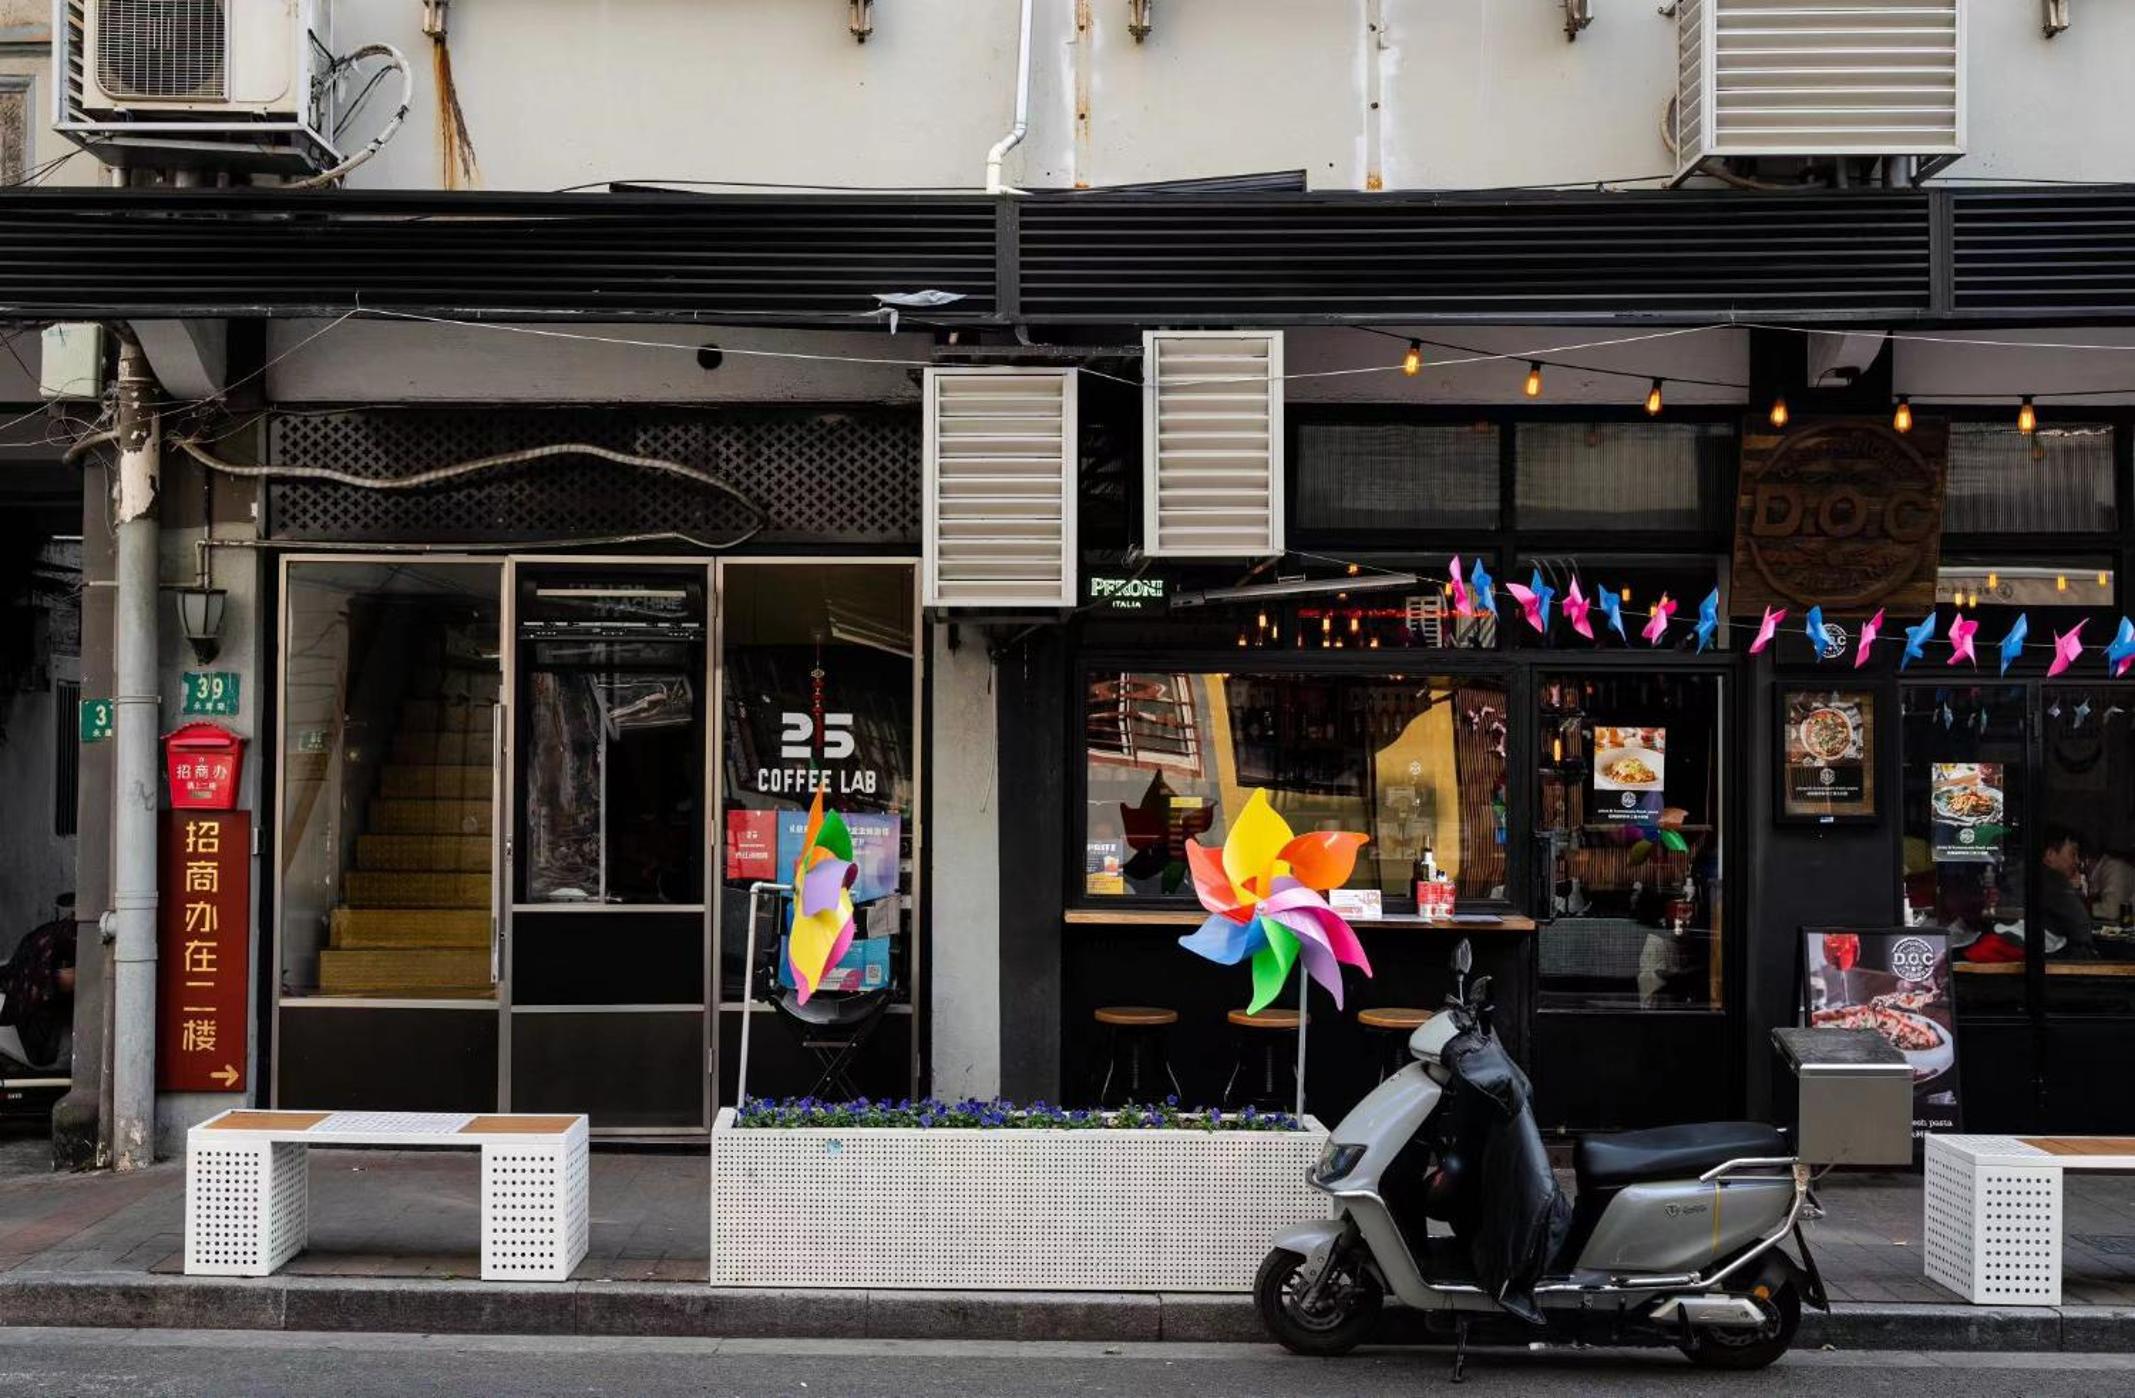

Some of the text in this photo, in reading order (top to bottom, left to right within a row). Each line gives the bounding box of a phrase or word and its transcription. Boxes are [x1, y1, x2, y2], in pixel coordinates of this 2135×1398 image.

[1091, 577, 1164, 597] PERONI
[1112, 600, 1142, 608] ITALIA
[196, 677, 224, 699] 39
[95, 704, 111, 726] 3
[781, 712, 855, 759] 25
[176, 764, 228, 780] 招商办
[758, 768, 877, 794] COFFEE LAB
[182, 821, 220, 1051] 招商办在二楼
